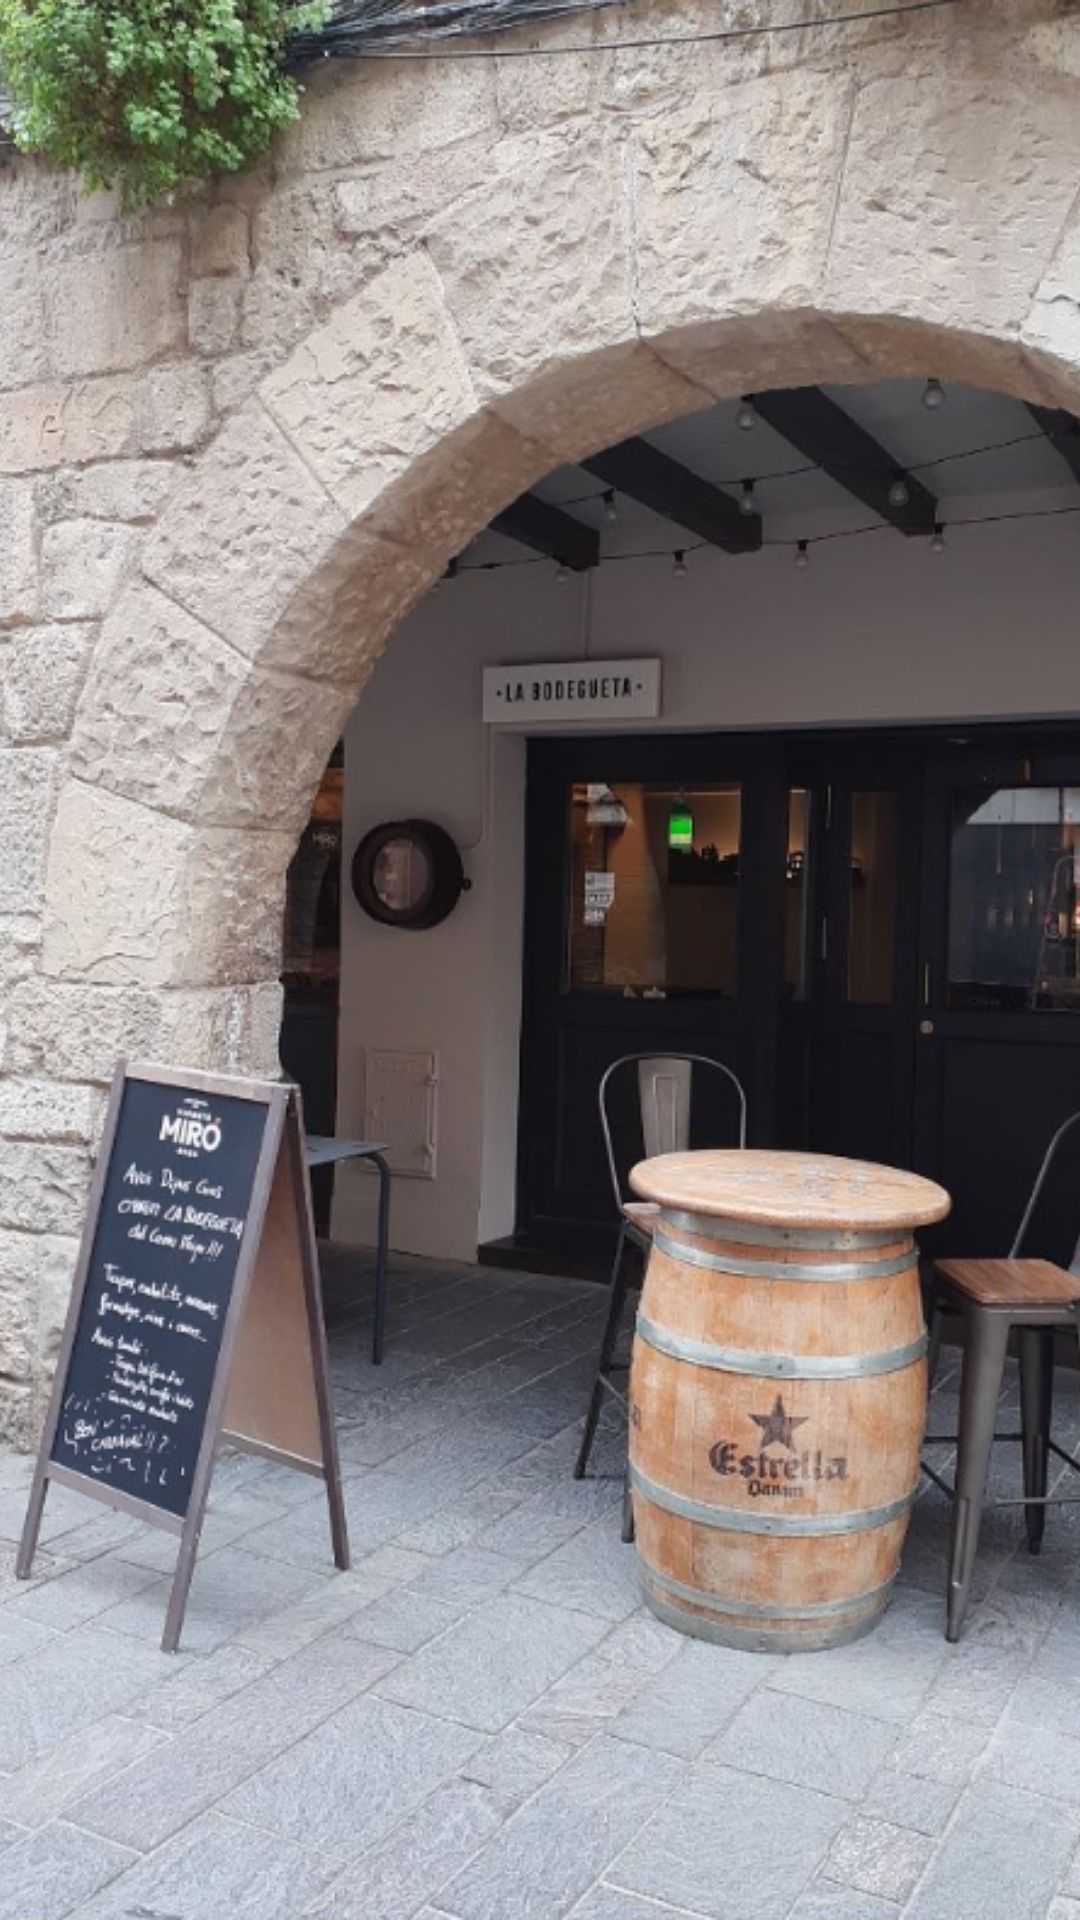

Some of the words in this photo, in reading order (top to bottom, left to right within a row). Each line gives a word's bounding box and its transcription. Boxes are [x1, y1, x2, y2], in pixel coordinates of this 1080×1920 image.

[505, 682, 525, 703] LA
[533, 677, 632, 701] BODEGUETA
[709, 1440, 848, 1481] Estrella
